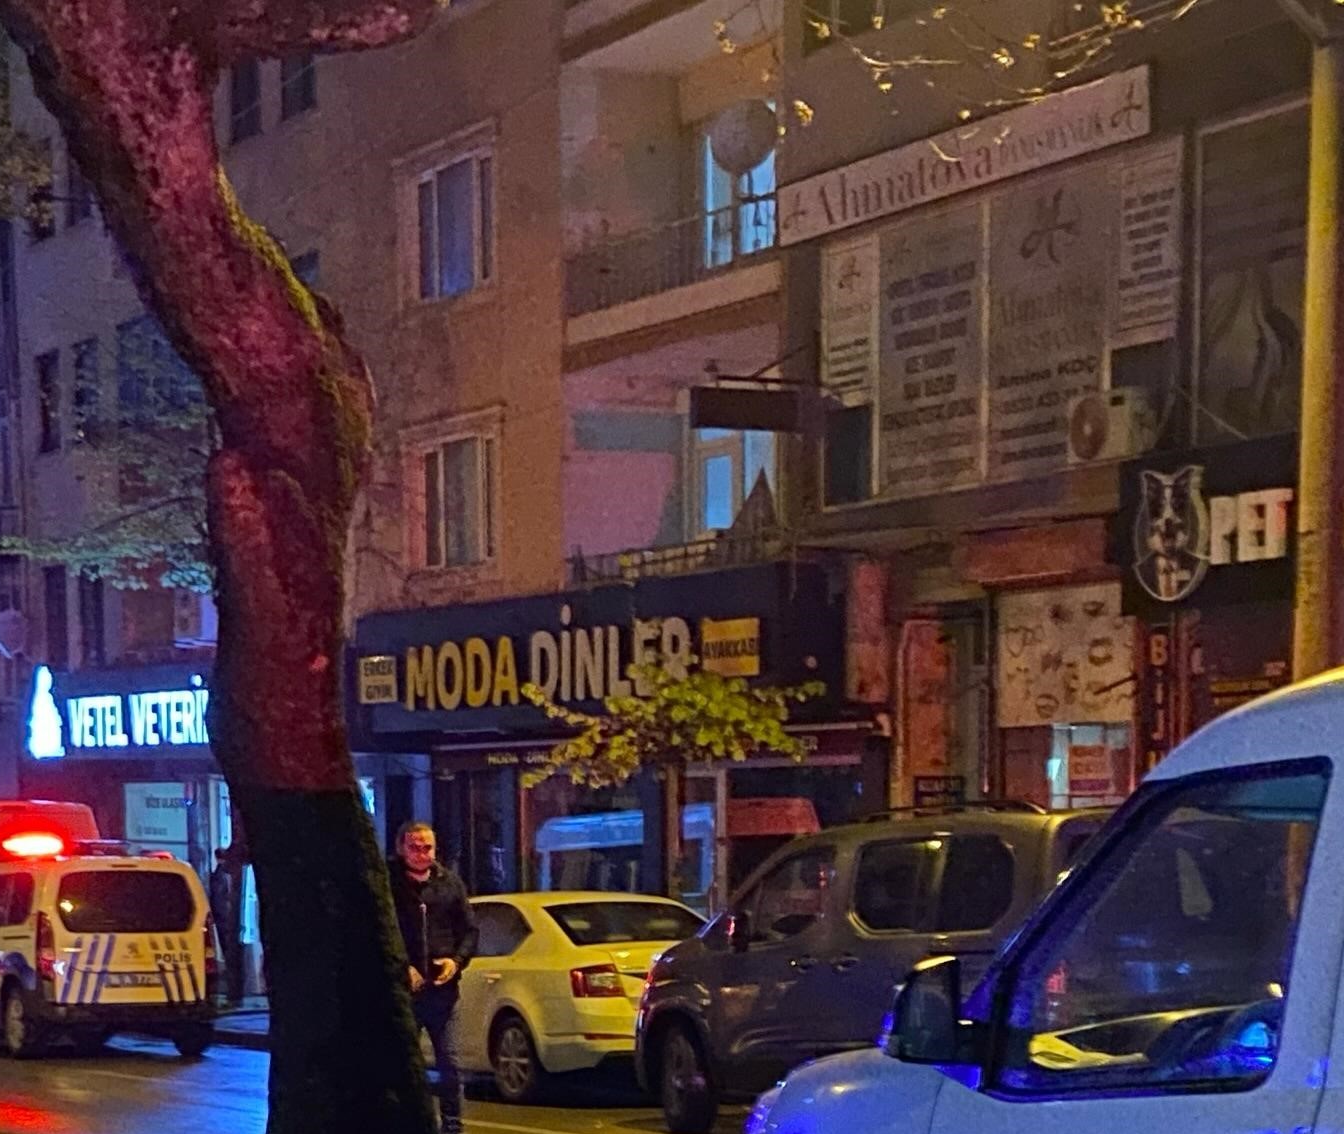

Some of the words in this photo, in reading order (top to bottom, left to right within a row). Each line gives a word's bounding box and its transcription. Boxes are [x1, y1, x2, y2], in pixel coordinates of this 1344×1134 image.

[1209, 487, 1294, 566] PET
[405, 635, 520, 712] MODA
[66, 695, 129, 748] VETEL
